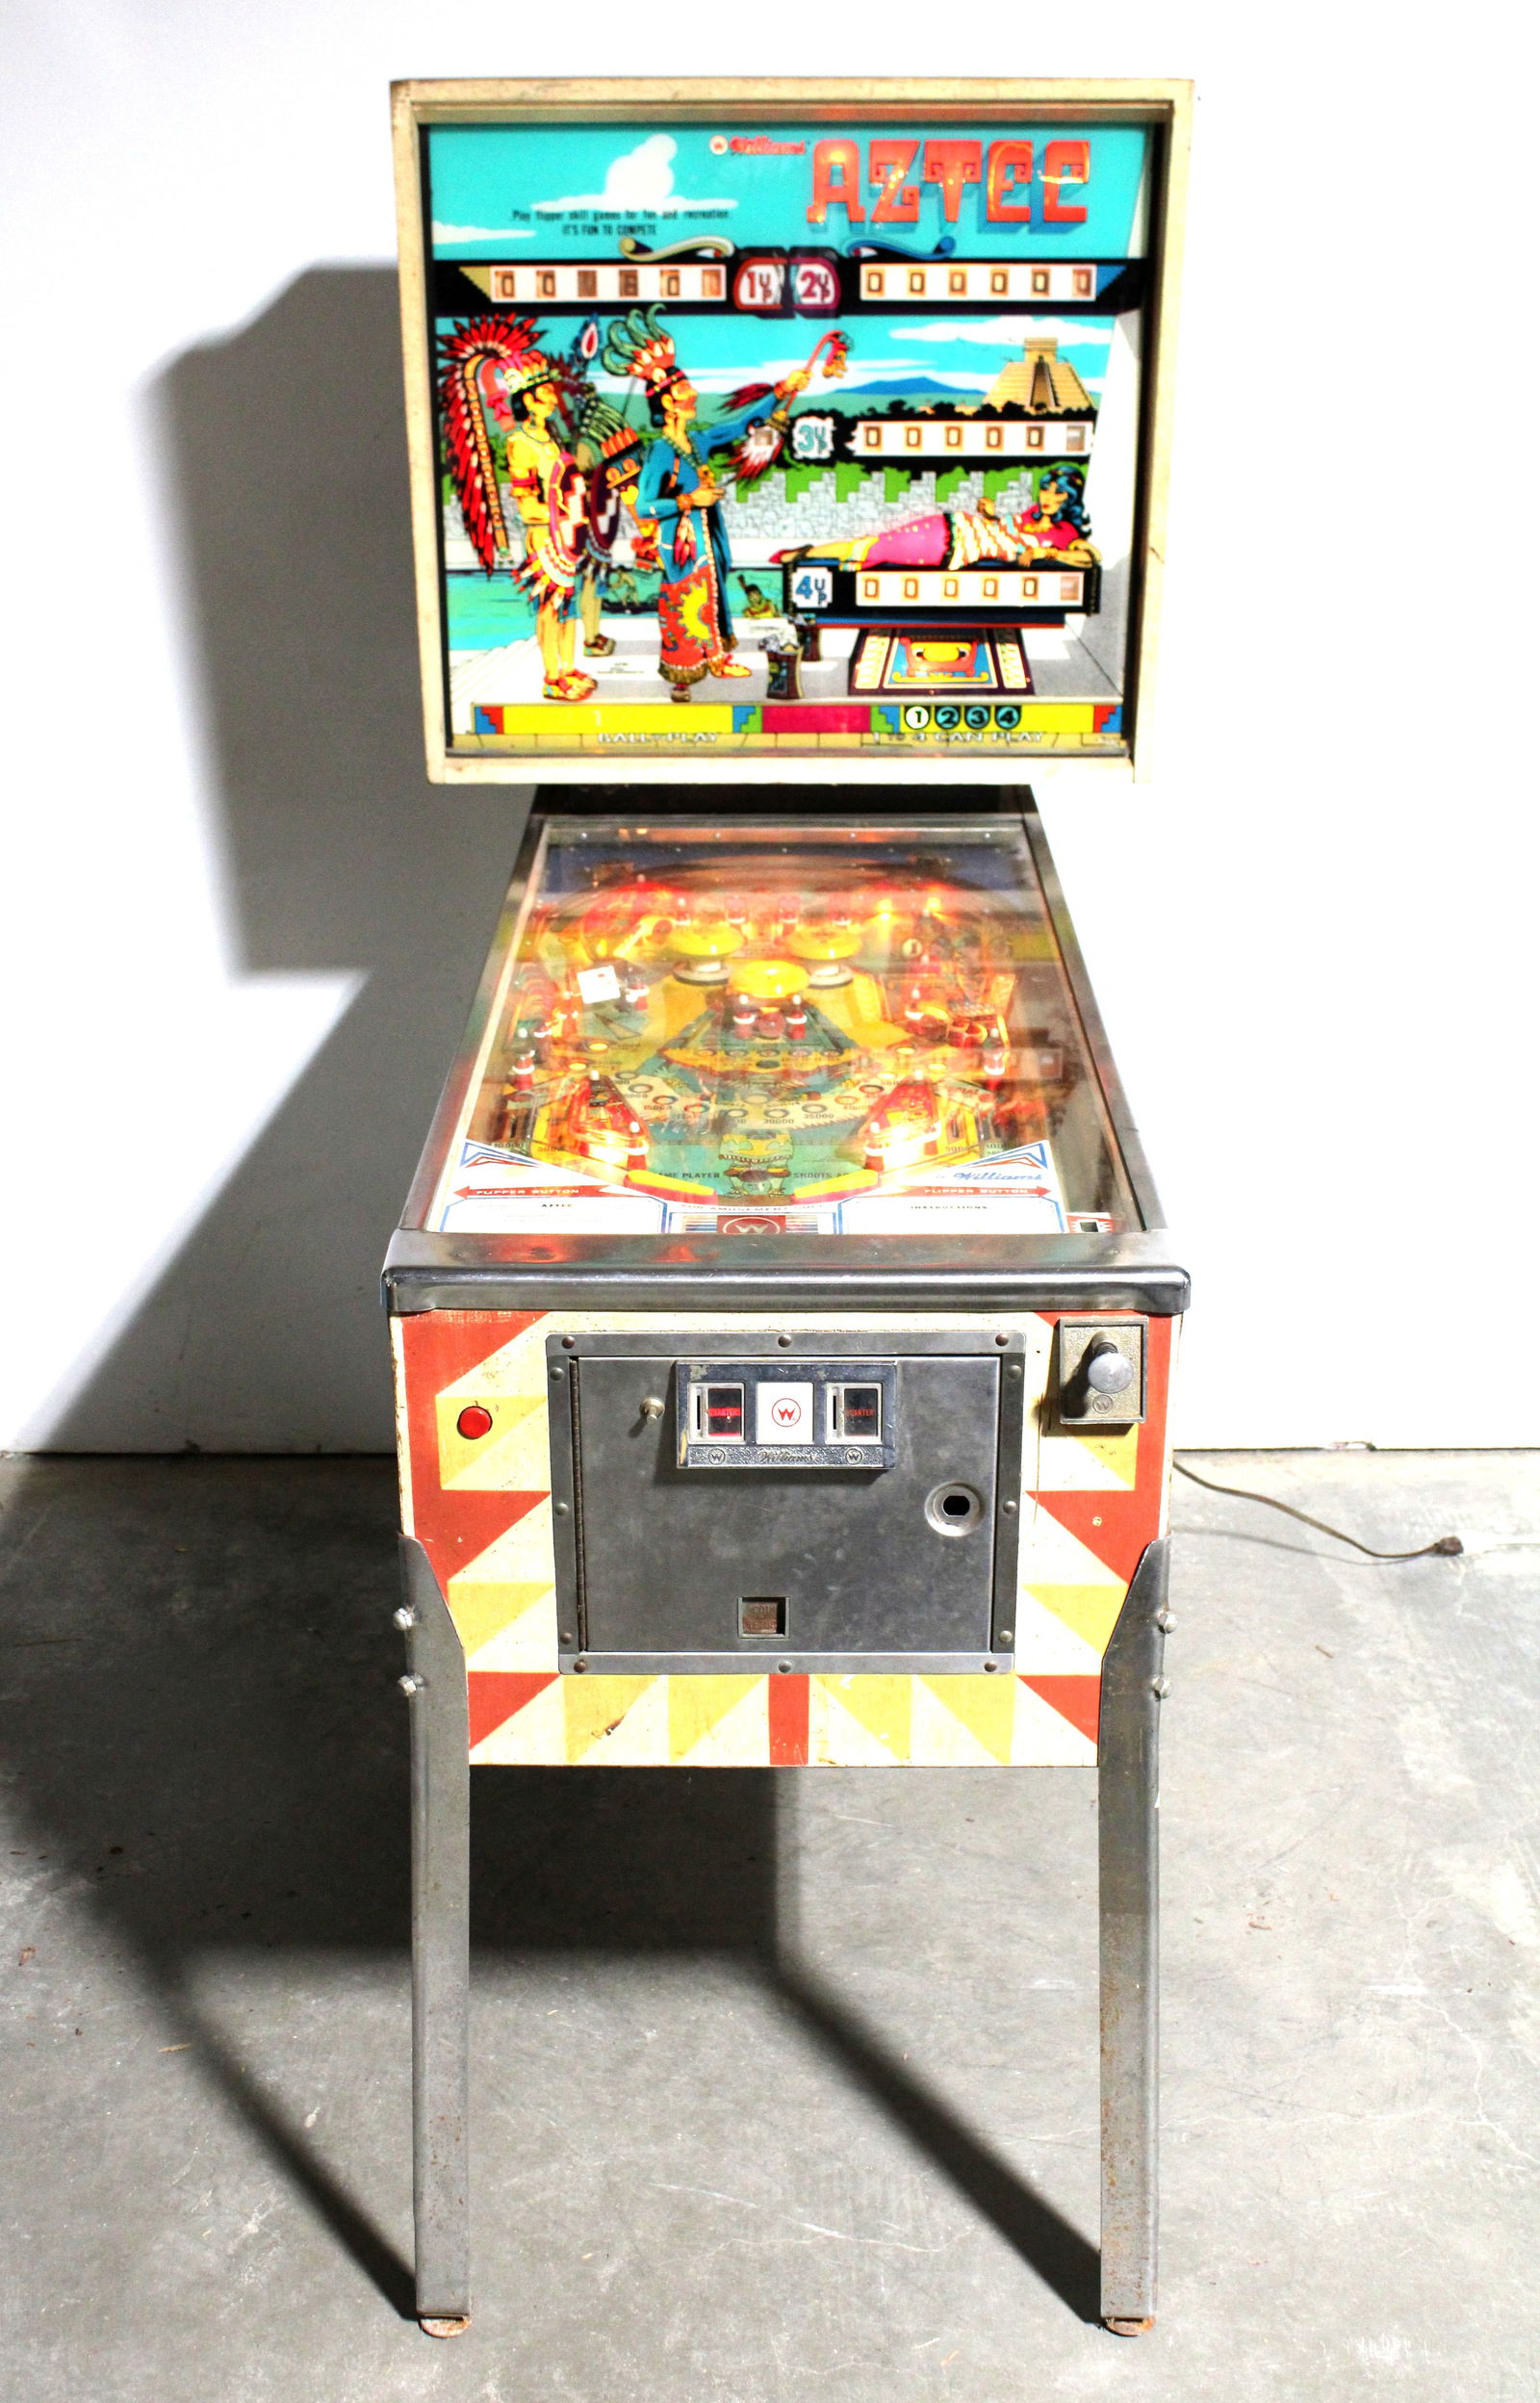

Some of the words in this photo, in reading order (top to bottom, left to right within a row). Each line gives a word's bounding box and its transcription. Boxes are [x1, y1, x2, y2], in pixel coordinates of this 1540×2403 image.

[807, 139, 1090, 223] AZTEC
[598, 732, 648, 743] BALL
[666, 732, 718, 743] PLAY
[935, 732, 984, 742] CAN
[991, 732, 1046, 742] PLAY
[794, 1172, 833, 1180] SHOOTS
[954, 1172, 1043, 1180] Williams
[757, 1449, 814, 1462] Williams
